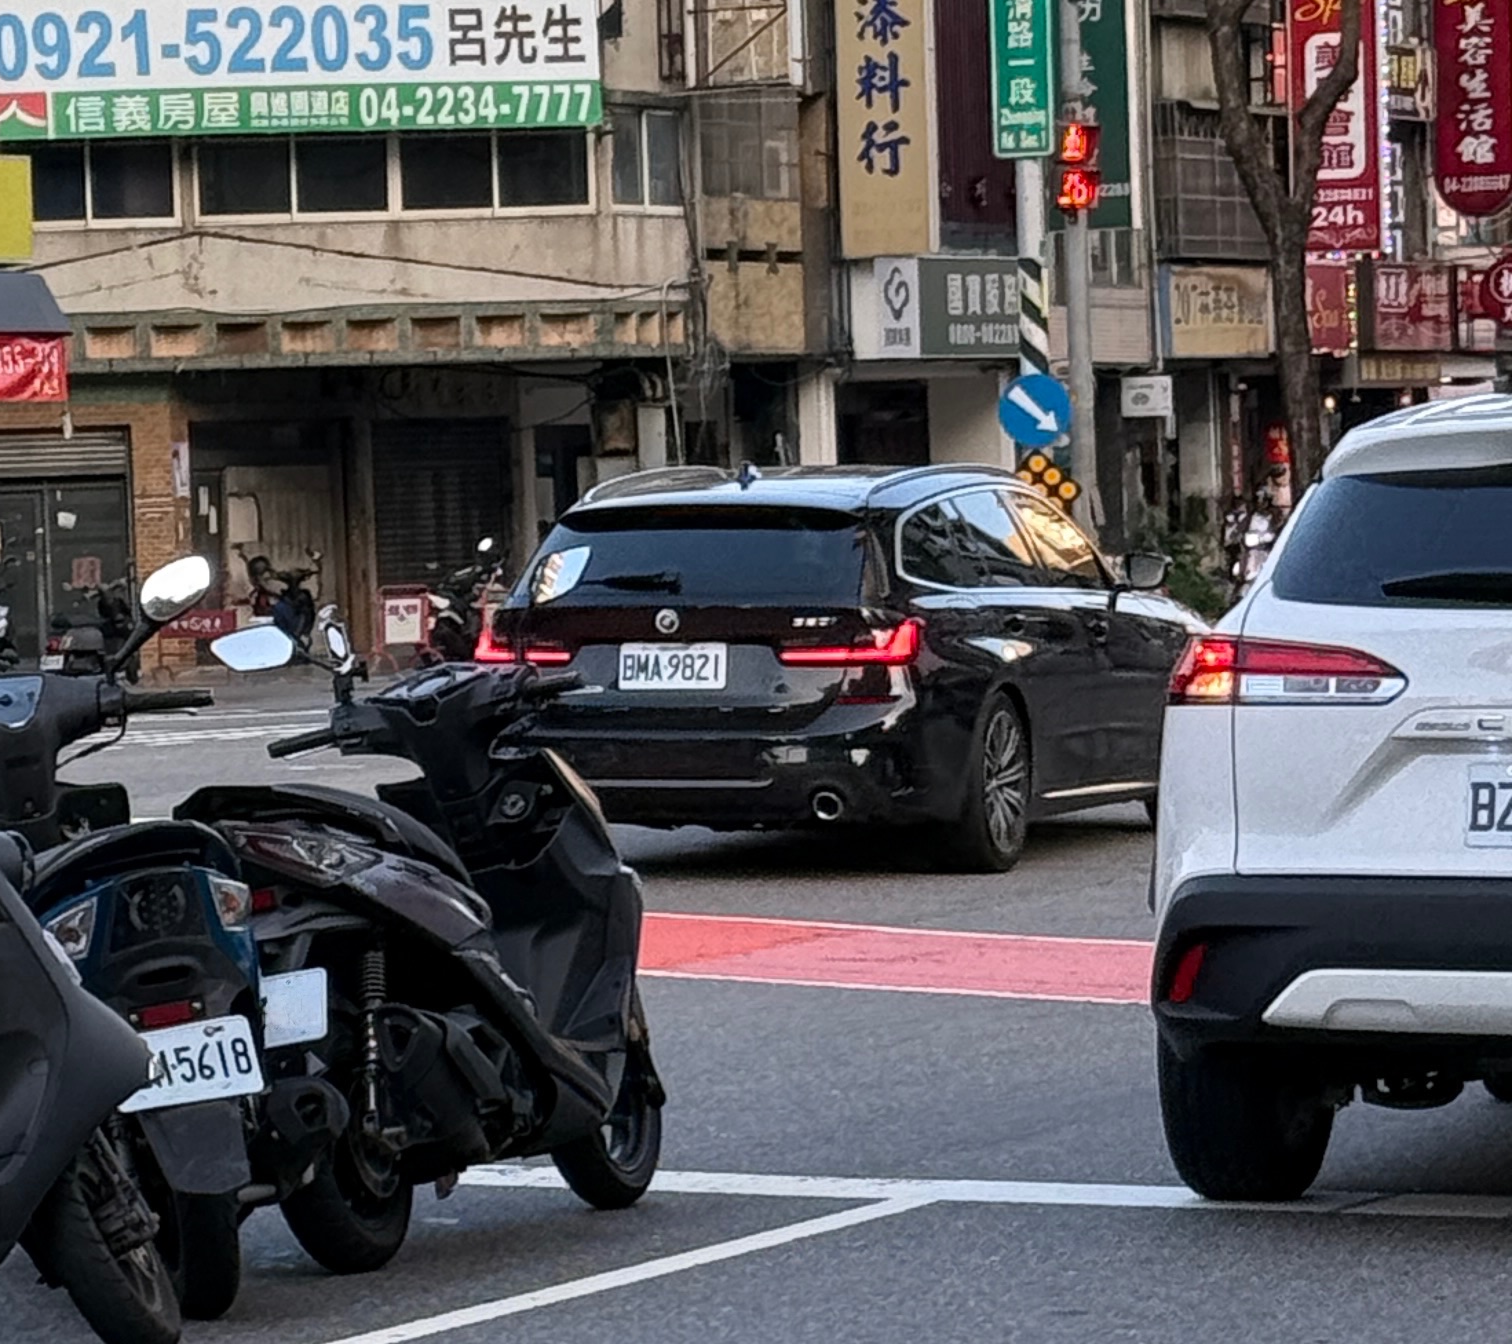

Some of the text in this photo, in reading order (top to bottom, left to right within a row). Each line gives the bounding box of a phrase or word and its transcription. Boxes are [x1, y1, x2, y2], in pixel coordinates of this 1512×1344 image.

[446, 2, 587, 68] 呂先生
[65, 91, 242, 133] 信義房屋
[359, 83, 593, 127] 04-2234-7777
[1455, 5, 1498, 165] 美容生活館
[1310, 203, 1365, 228] 24h
[622, 653, 720, 682] BMA-9821
